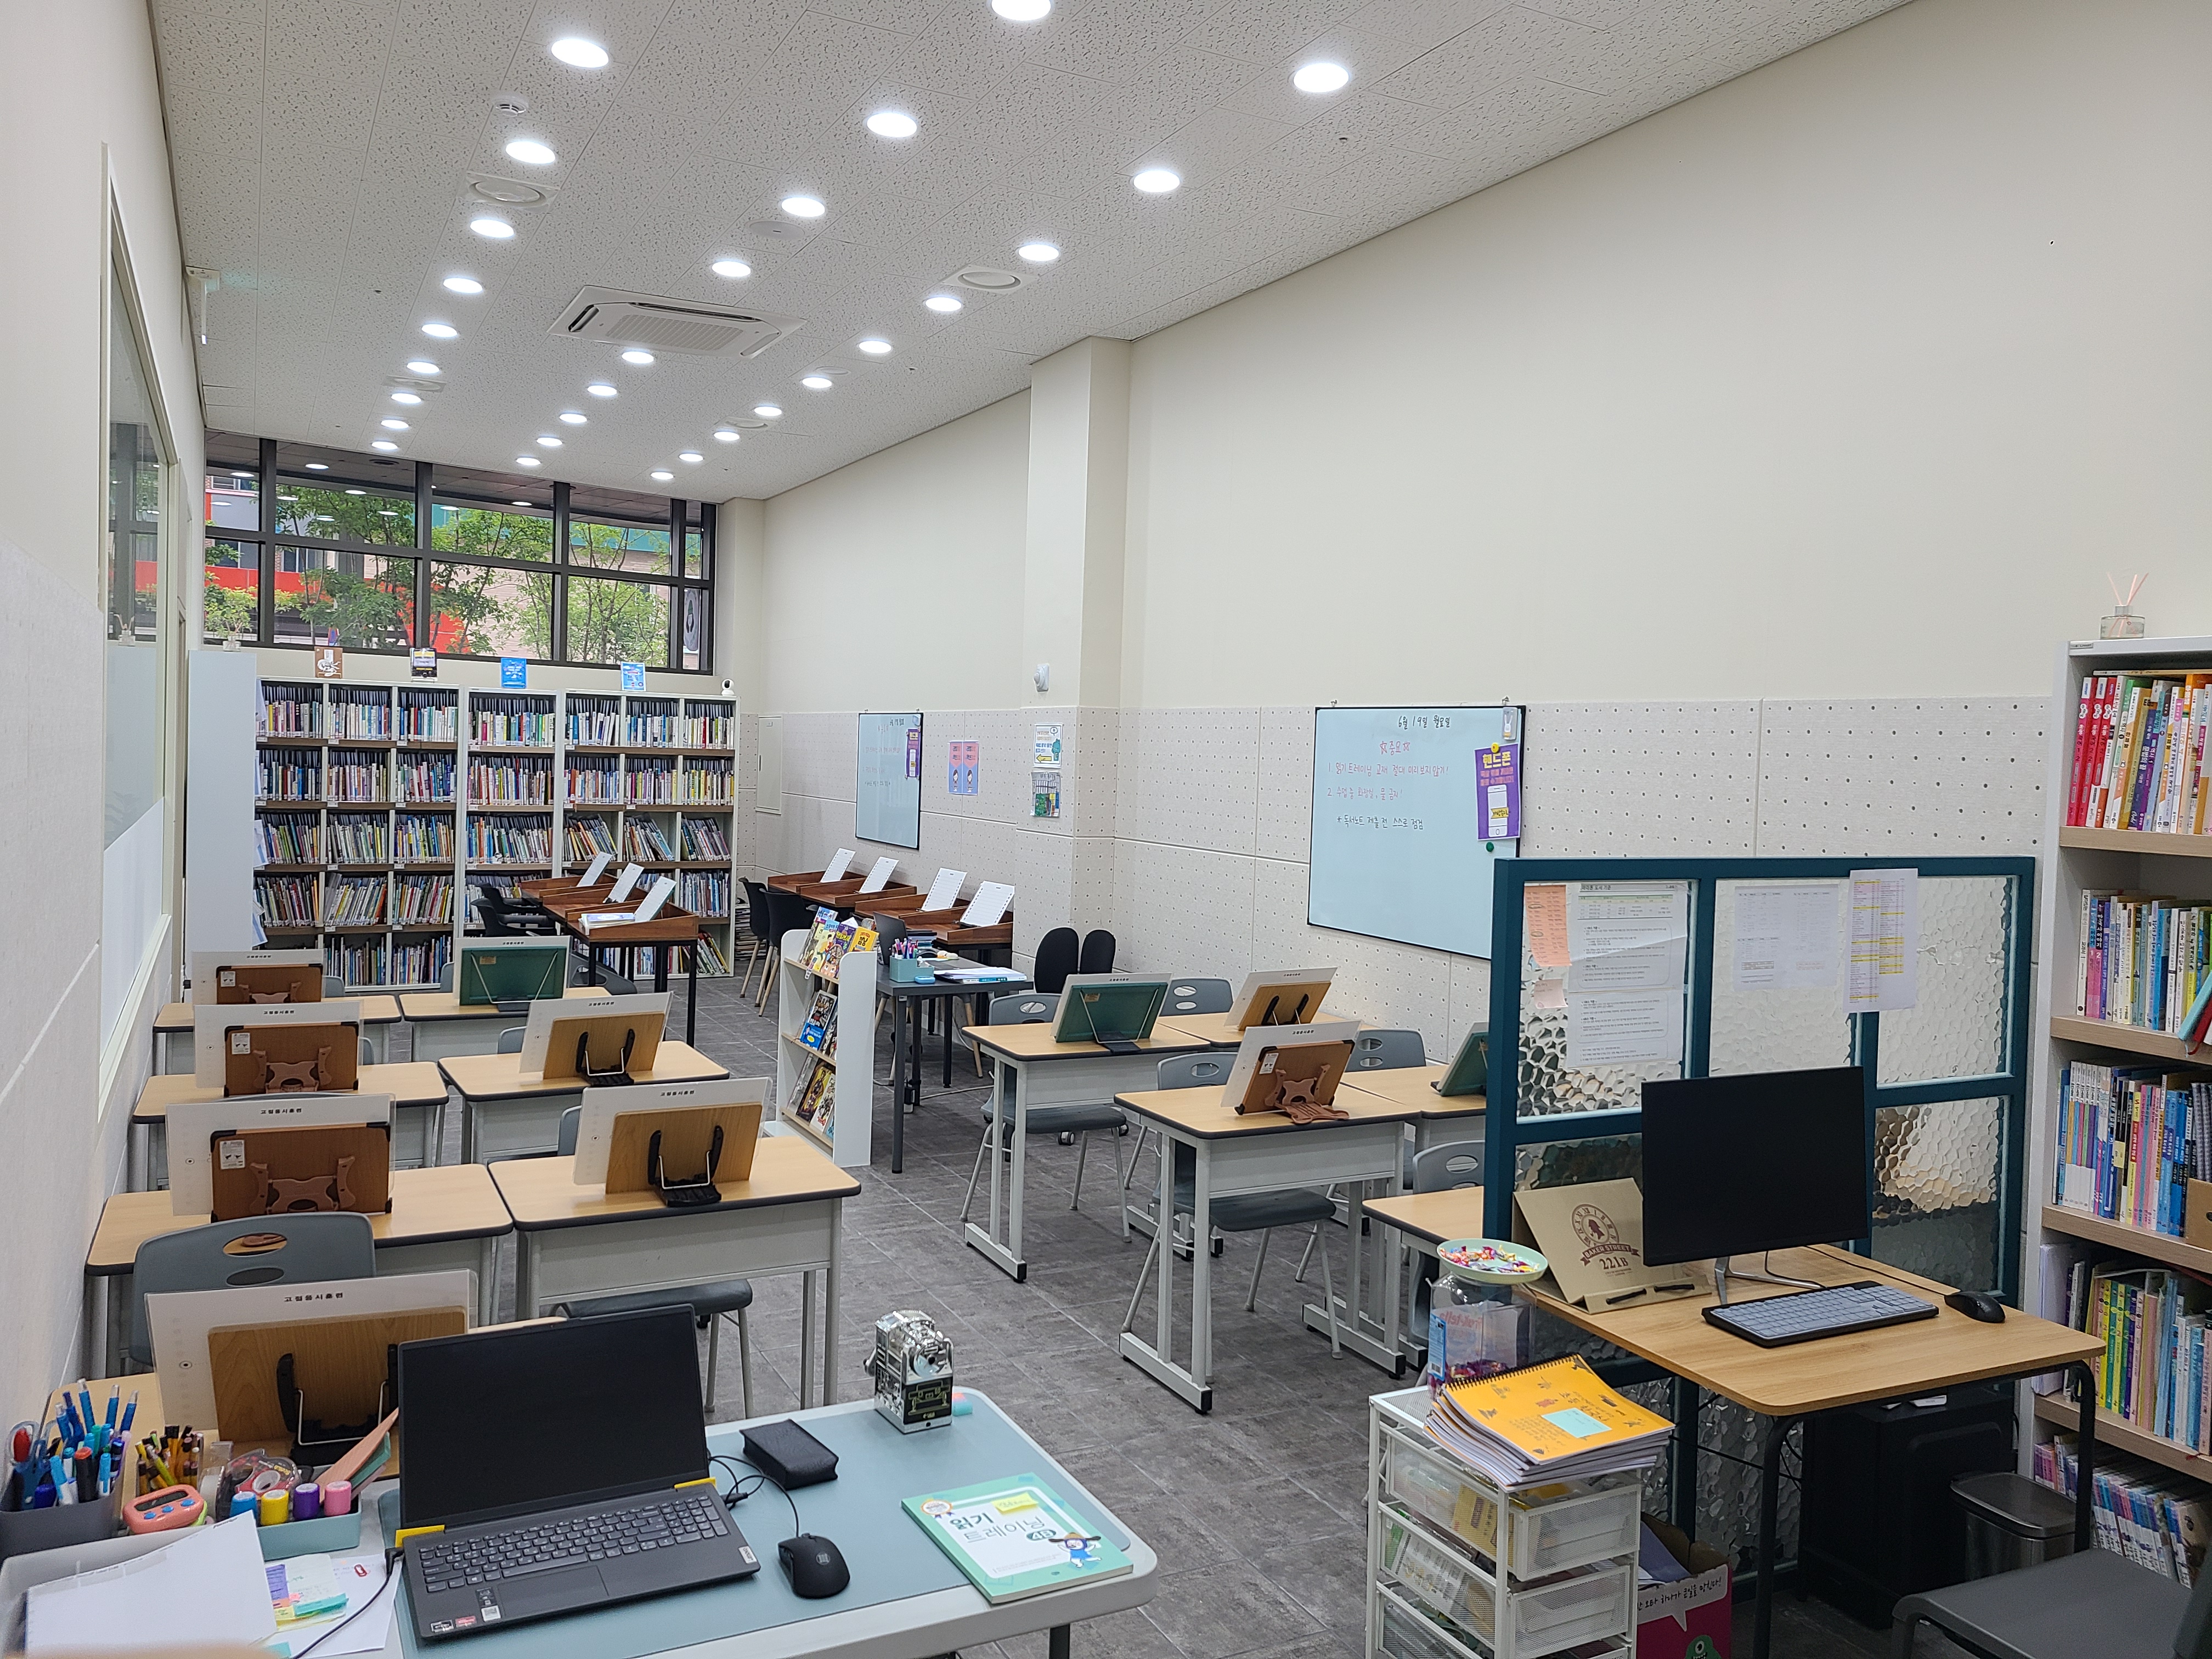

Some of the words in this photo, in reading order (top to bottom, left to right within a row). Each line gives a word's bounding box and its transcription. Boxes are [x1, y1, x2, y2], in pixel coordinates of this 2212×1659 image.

[1398, 715, 1408, 730] 6월
[1412, 715, 1427, 728] 19일
[1433, 715, 1451, 728] 월요일
[1389, 741, 1401, 755] 중요
[2140, 746, 2149, 763] 문법의
[2149, 748, 2156, 758] 역사
[1482, 751, 1511, 769] 핸드폰
[1335, 762, 1346, 775] 읽기
[1348, 763, 1372, 776] 트레이닝
[1376, 764, 1387, 775] 교재
[1392, 764, 1405, 776] 절대
[1408, 766, 1419, 774] 미리
[1420, 765, 1431, 775] 보지
[1336, 786, 1347, 798] 수업
[1348, 787, 1354, 799] 중
[1380, 787, 1386, 800] 물
[1344, 814, 1364, 828] 독서노트
[1367, 816, 1379, 828] 제출
[1381, 817, 1388, 828] 전
[1392, 817, 1408, 827] 스스로
[1410, 818, 1424, 830] 점검
[1584, 1246, 1605, 1258] BAKER
[1599, 1256, 1629, 1269] 221B
[950, 1513, 994, 1530] 읽기
[963, 1516, 1045, 1543] 트레이닝
[1645, 1598, 1658, 1608] 오타
[1661, 1592, 1681, 1604] 하나가
[1683, 1584, 1697, 1599] 큰일을
[1699, 1577, 1722, 1593] 망친다!
